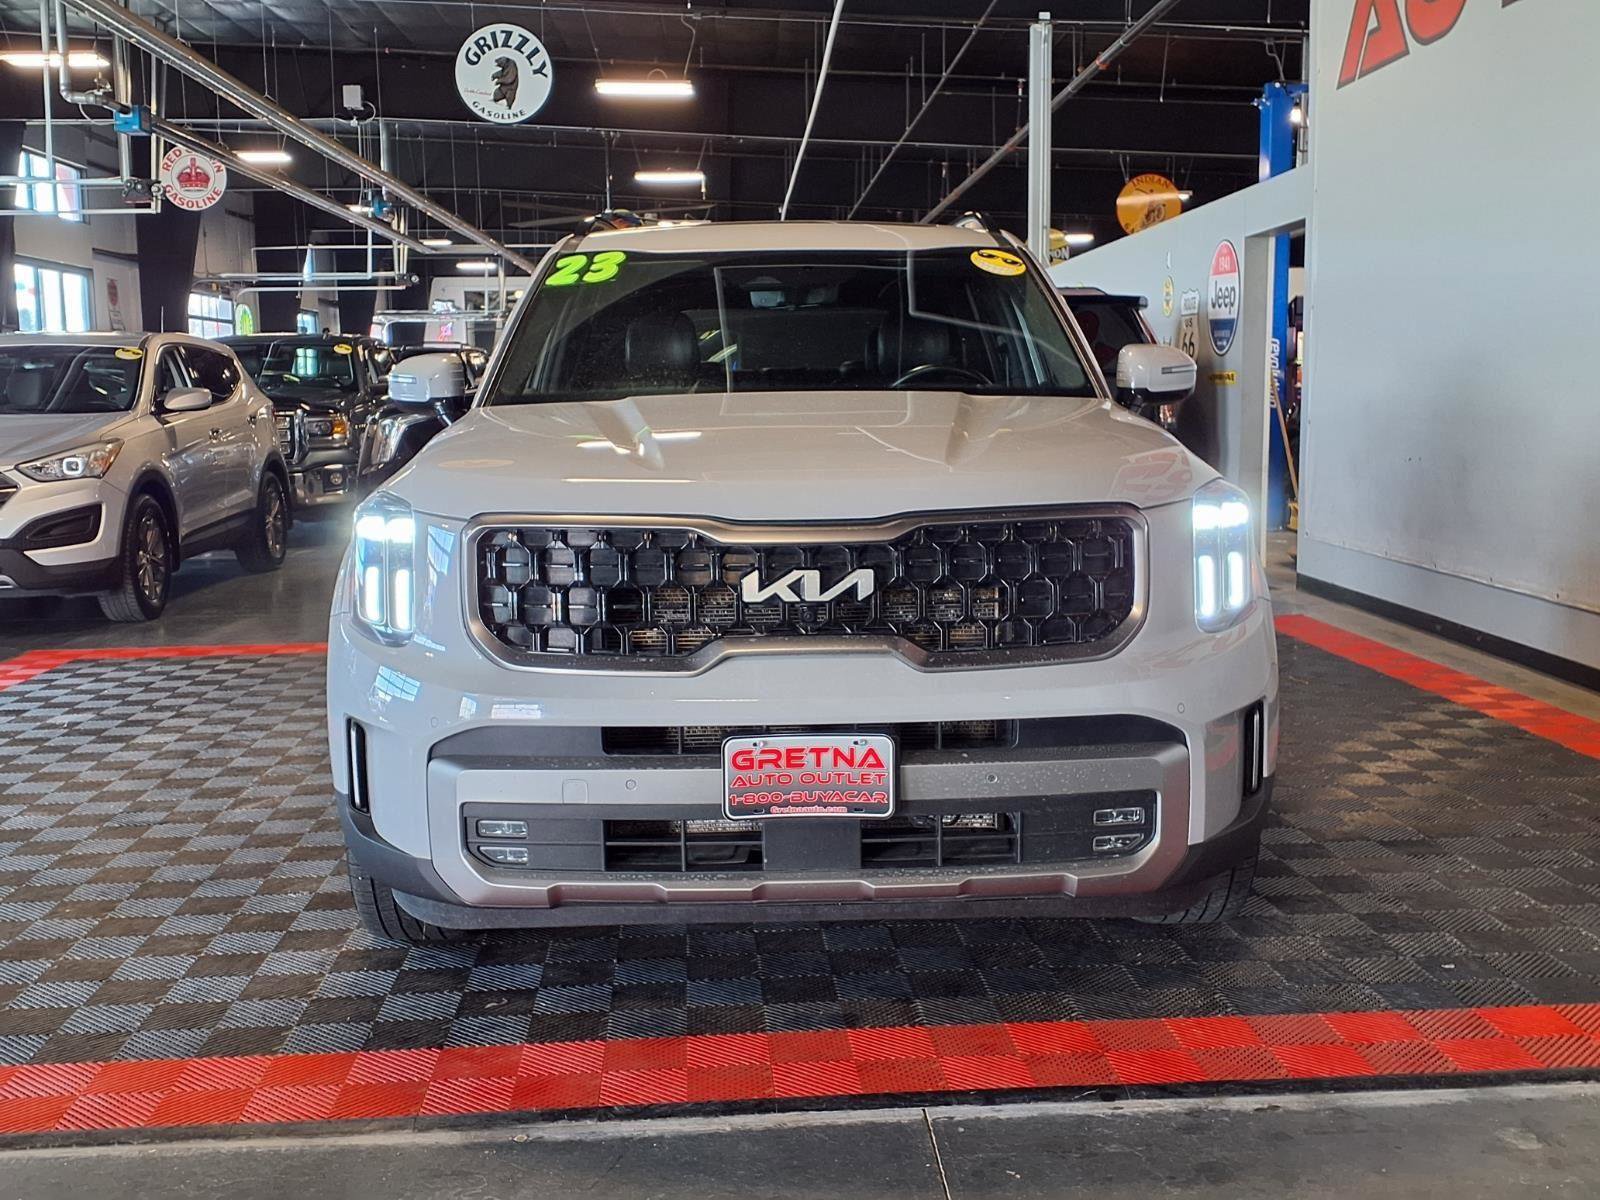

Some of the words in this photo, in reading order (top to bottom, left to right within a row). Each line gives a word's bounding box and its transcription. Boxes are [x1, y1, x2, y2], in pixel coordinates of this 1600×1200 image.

[465, 30, 548, 78] GRIZZLY
[472, 101, 527, 119] GASOLINE
[162, 148, 182, 172] RED
[165, 184, 222, 208] GASOLINE
[545, 251, 627, 286] 23
[1211, 280, 1236, 315] Jeep
[1182, 332, 1195, 358] 66
[741, 568, 874, 603] KIA
[731, 747, 887, 771] GRETNA
[731, 773, 794, 788] AUTO
[799, 772, 888, 786] OUTLET
[730, 791, 888, 806] 1-800-BUYACAR
